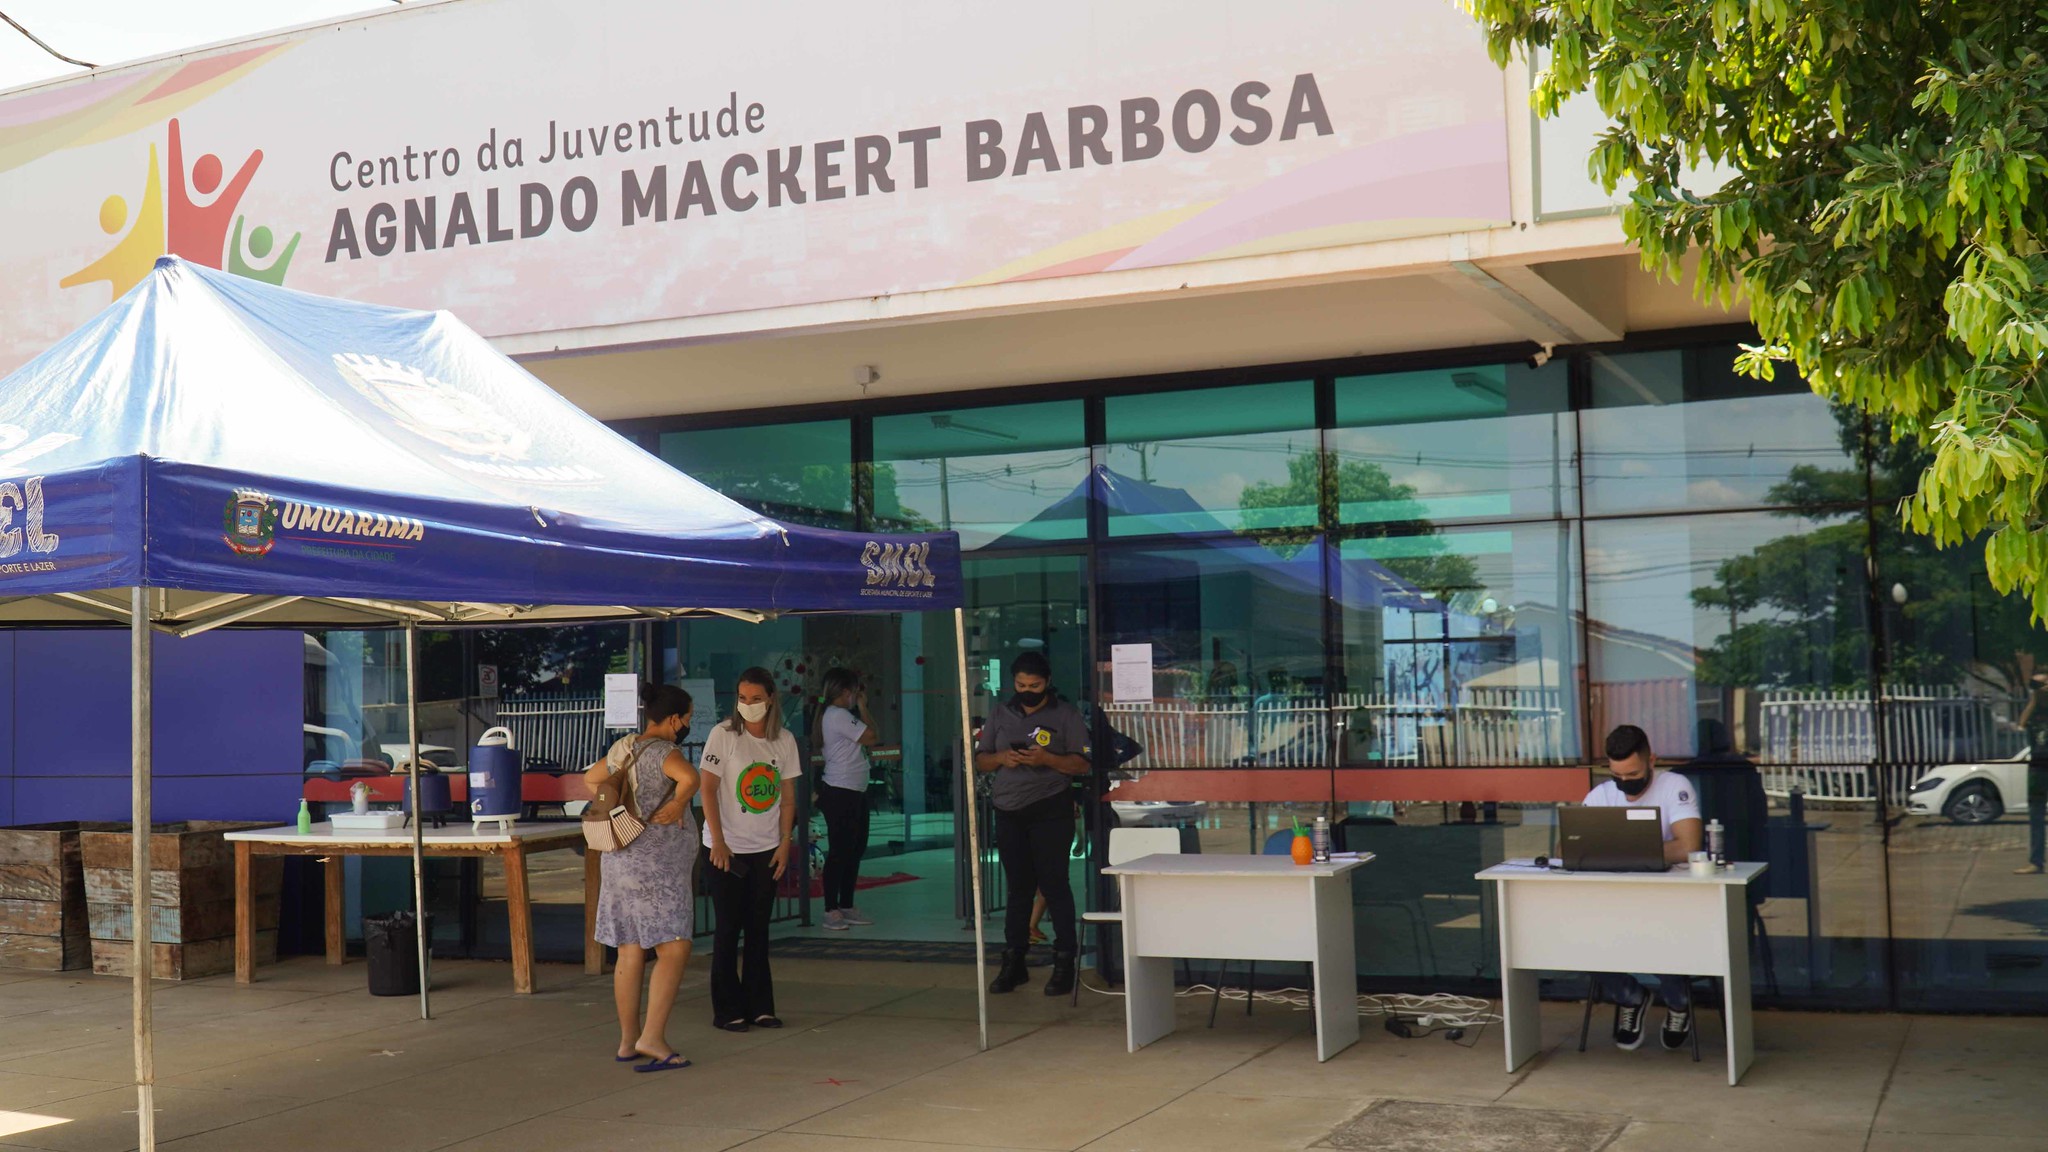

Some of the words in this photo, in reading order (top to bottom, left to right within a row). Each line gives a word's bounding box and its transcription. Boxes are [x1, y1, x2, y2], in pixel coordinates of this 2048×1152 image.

[330, 145, 460, 192] Centro
[477, 128, 524, 172] da
[539, 91, 766, 164] Juventude
[324, 175, 599, 263] AGNALDO
[621, 126, 941, 227] MACKERT
[965, 72, 1335, 183] BARBOSA
[281, 502, 424, 541] UMUARAMA
[0, 563, 23, 574] ORTE
[23, 562, 30, 572] E
[30, 561, 56, 572] LAZER
[365, 550, 395, 562] CIDADE
[860, 541, 936, 588] SMEL
